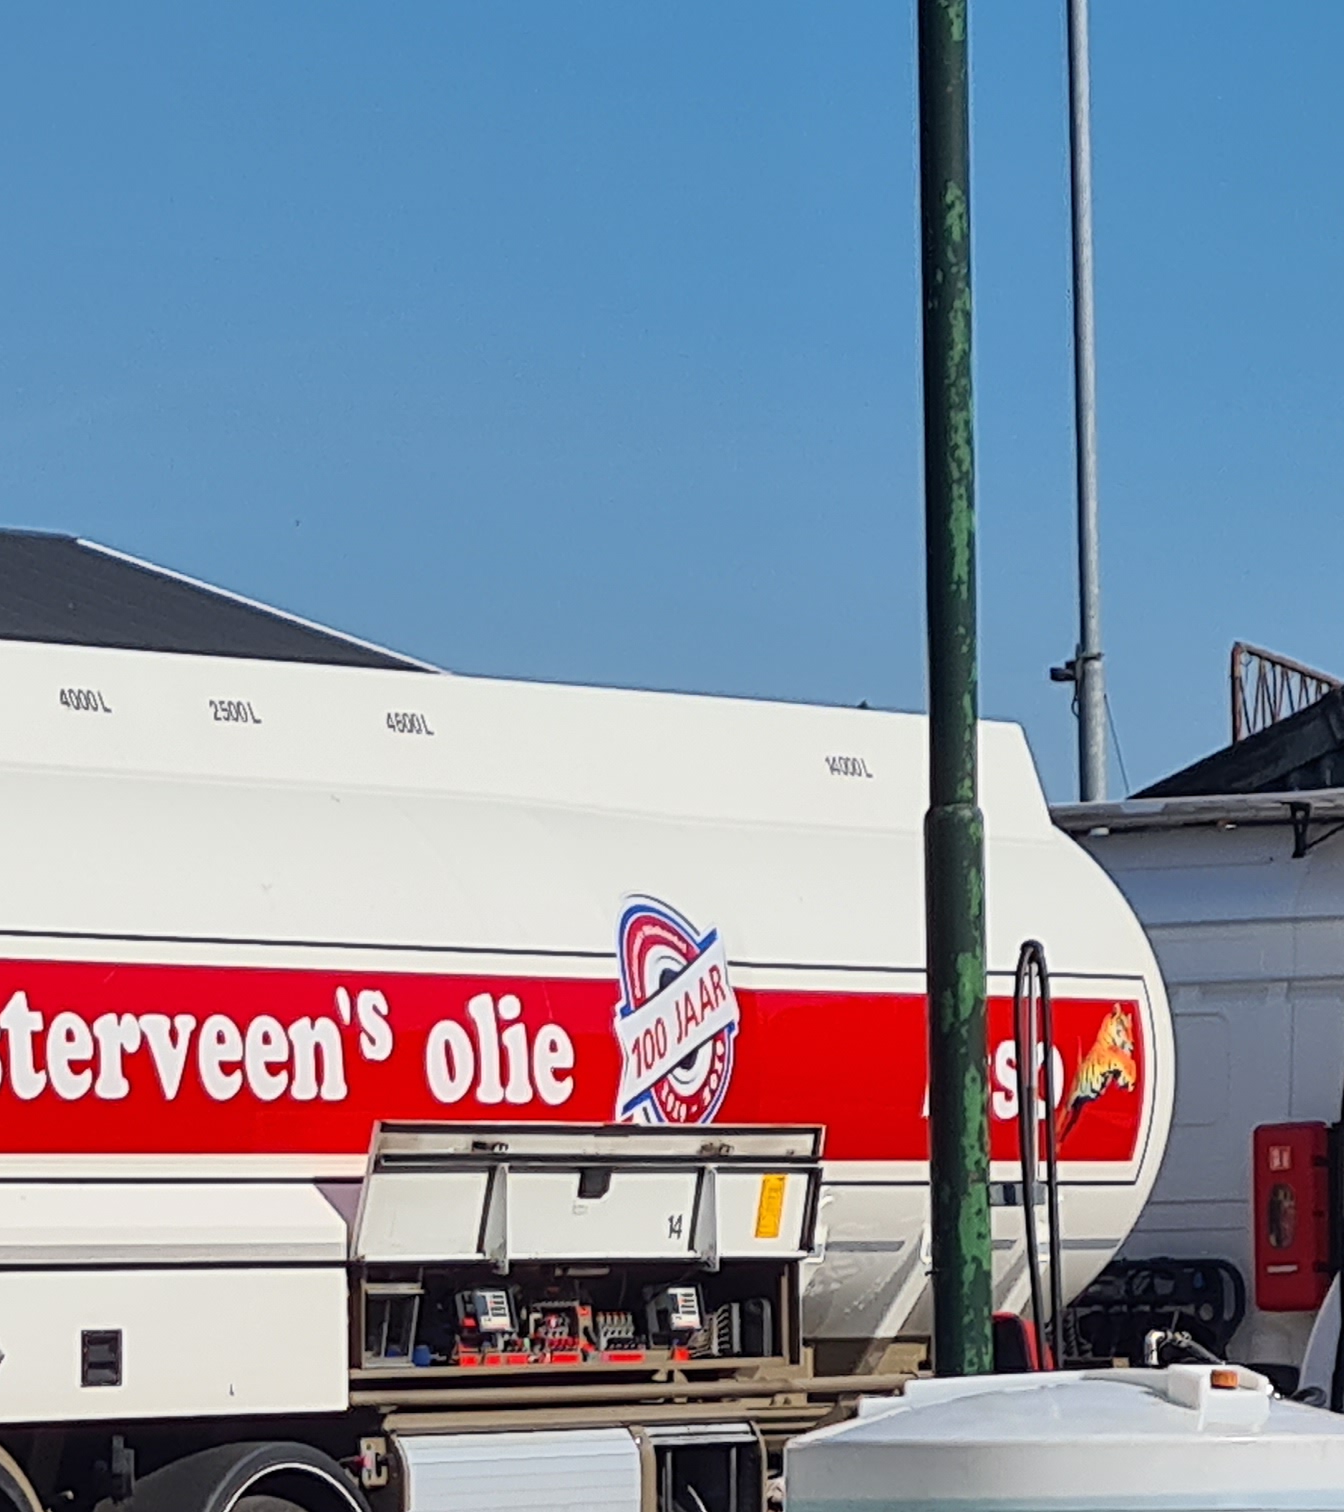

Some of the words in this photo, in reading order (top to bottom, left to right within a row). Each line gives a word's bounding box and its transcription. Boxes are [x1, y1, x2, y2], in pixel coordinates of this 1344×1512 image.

[59, 688, 113, 714] 4000L
[209, 699, 262, 725] 2500L
[824, 756, 873, 779] 14000L
[631, 1017, 668, 1079] 100
[675, 963, 727, 1045] JAAR
[424, 992, 576, 1106] olie
[667, 1213, 683, 1240] 14
